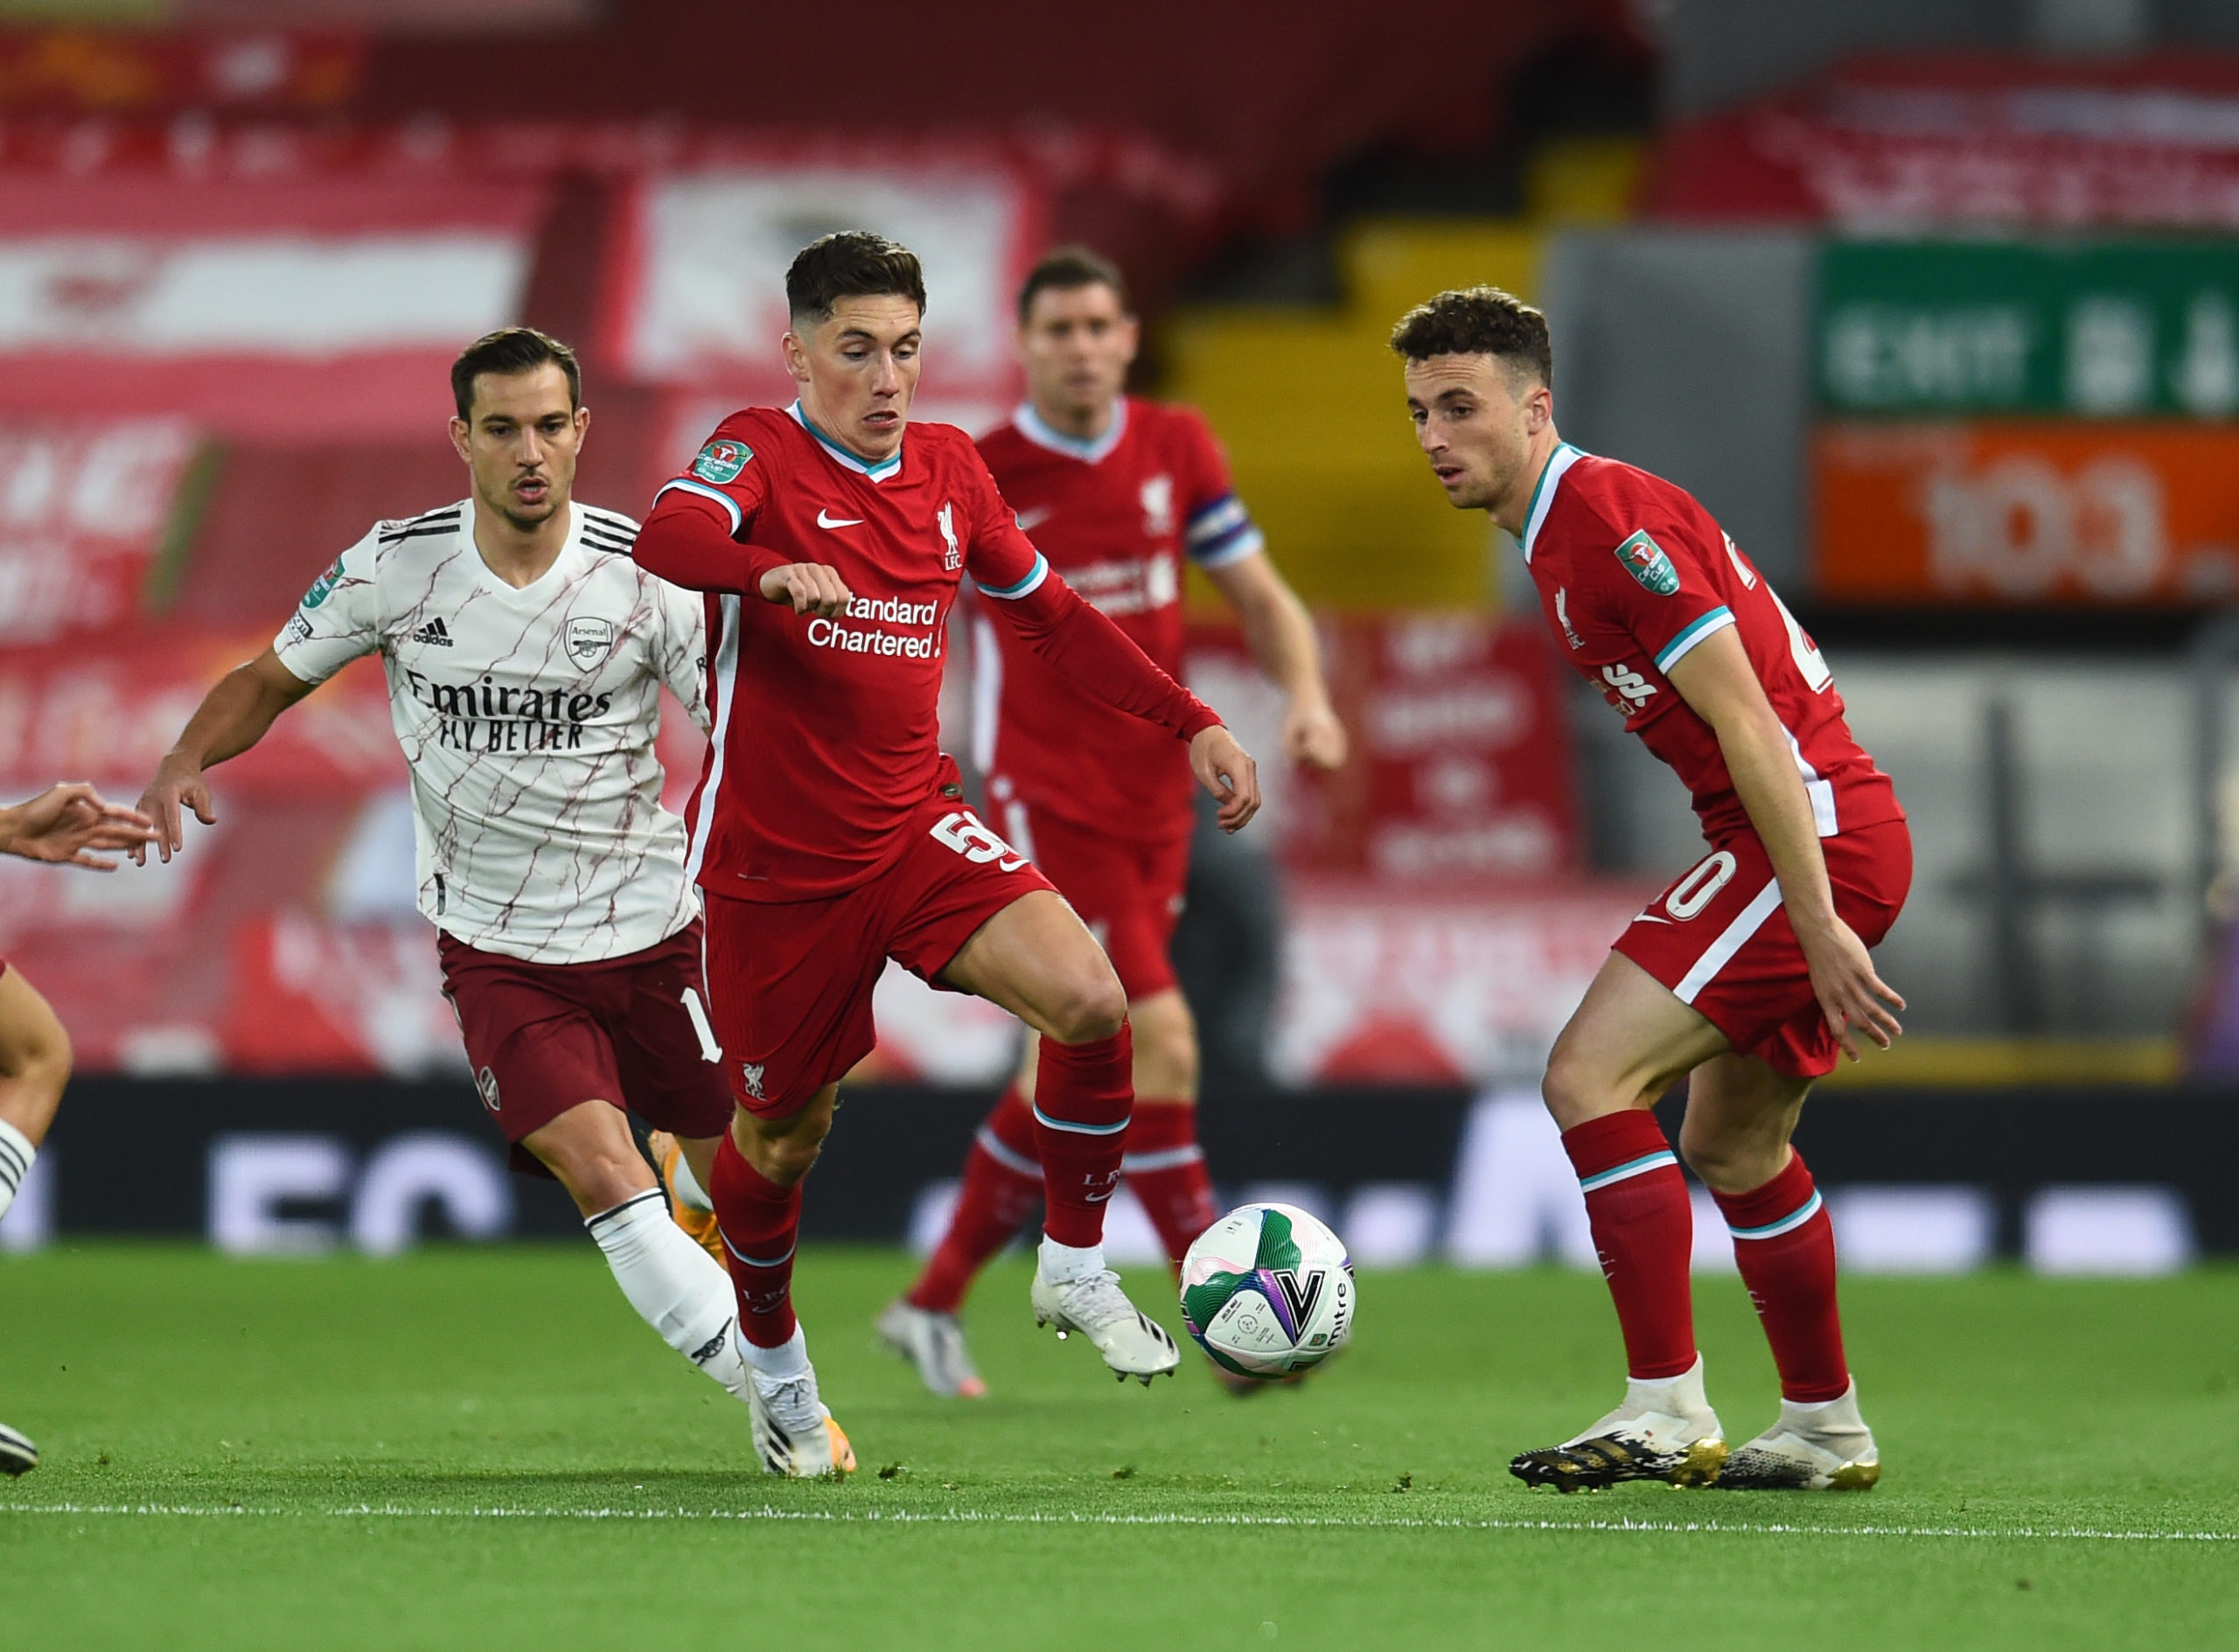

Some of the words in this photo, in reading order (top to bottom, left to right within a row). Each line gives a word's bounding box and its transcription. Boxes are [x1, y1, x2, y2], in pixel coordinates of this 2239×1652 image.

[945, 554, 963, 571] LFC
[845, 591, 938, 626] tandard
[413, 631, 454, 648] adidas
[571, 626, 607, 638] Arsenal
[807, 617, 933, 659] Chartered
[406, 668, 613, 723] Emirates
[439, 719, 477, 752] FLY
[488, 720, 583, 753] BETTER
[1327, 1282, 1347, 1348] mitre
